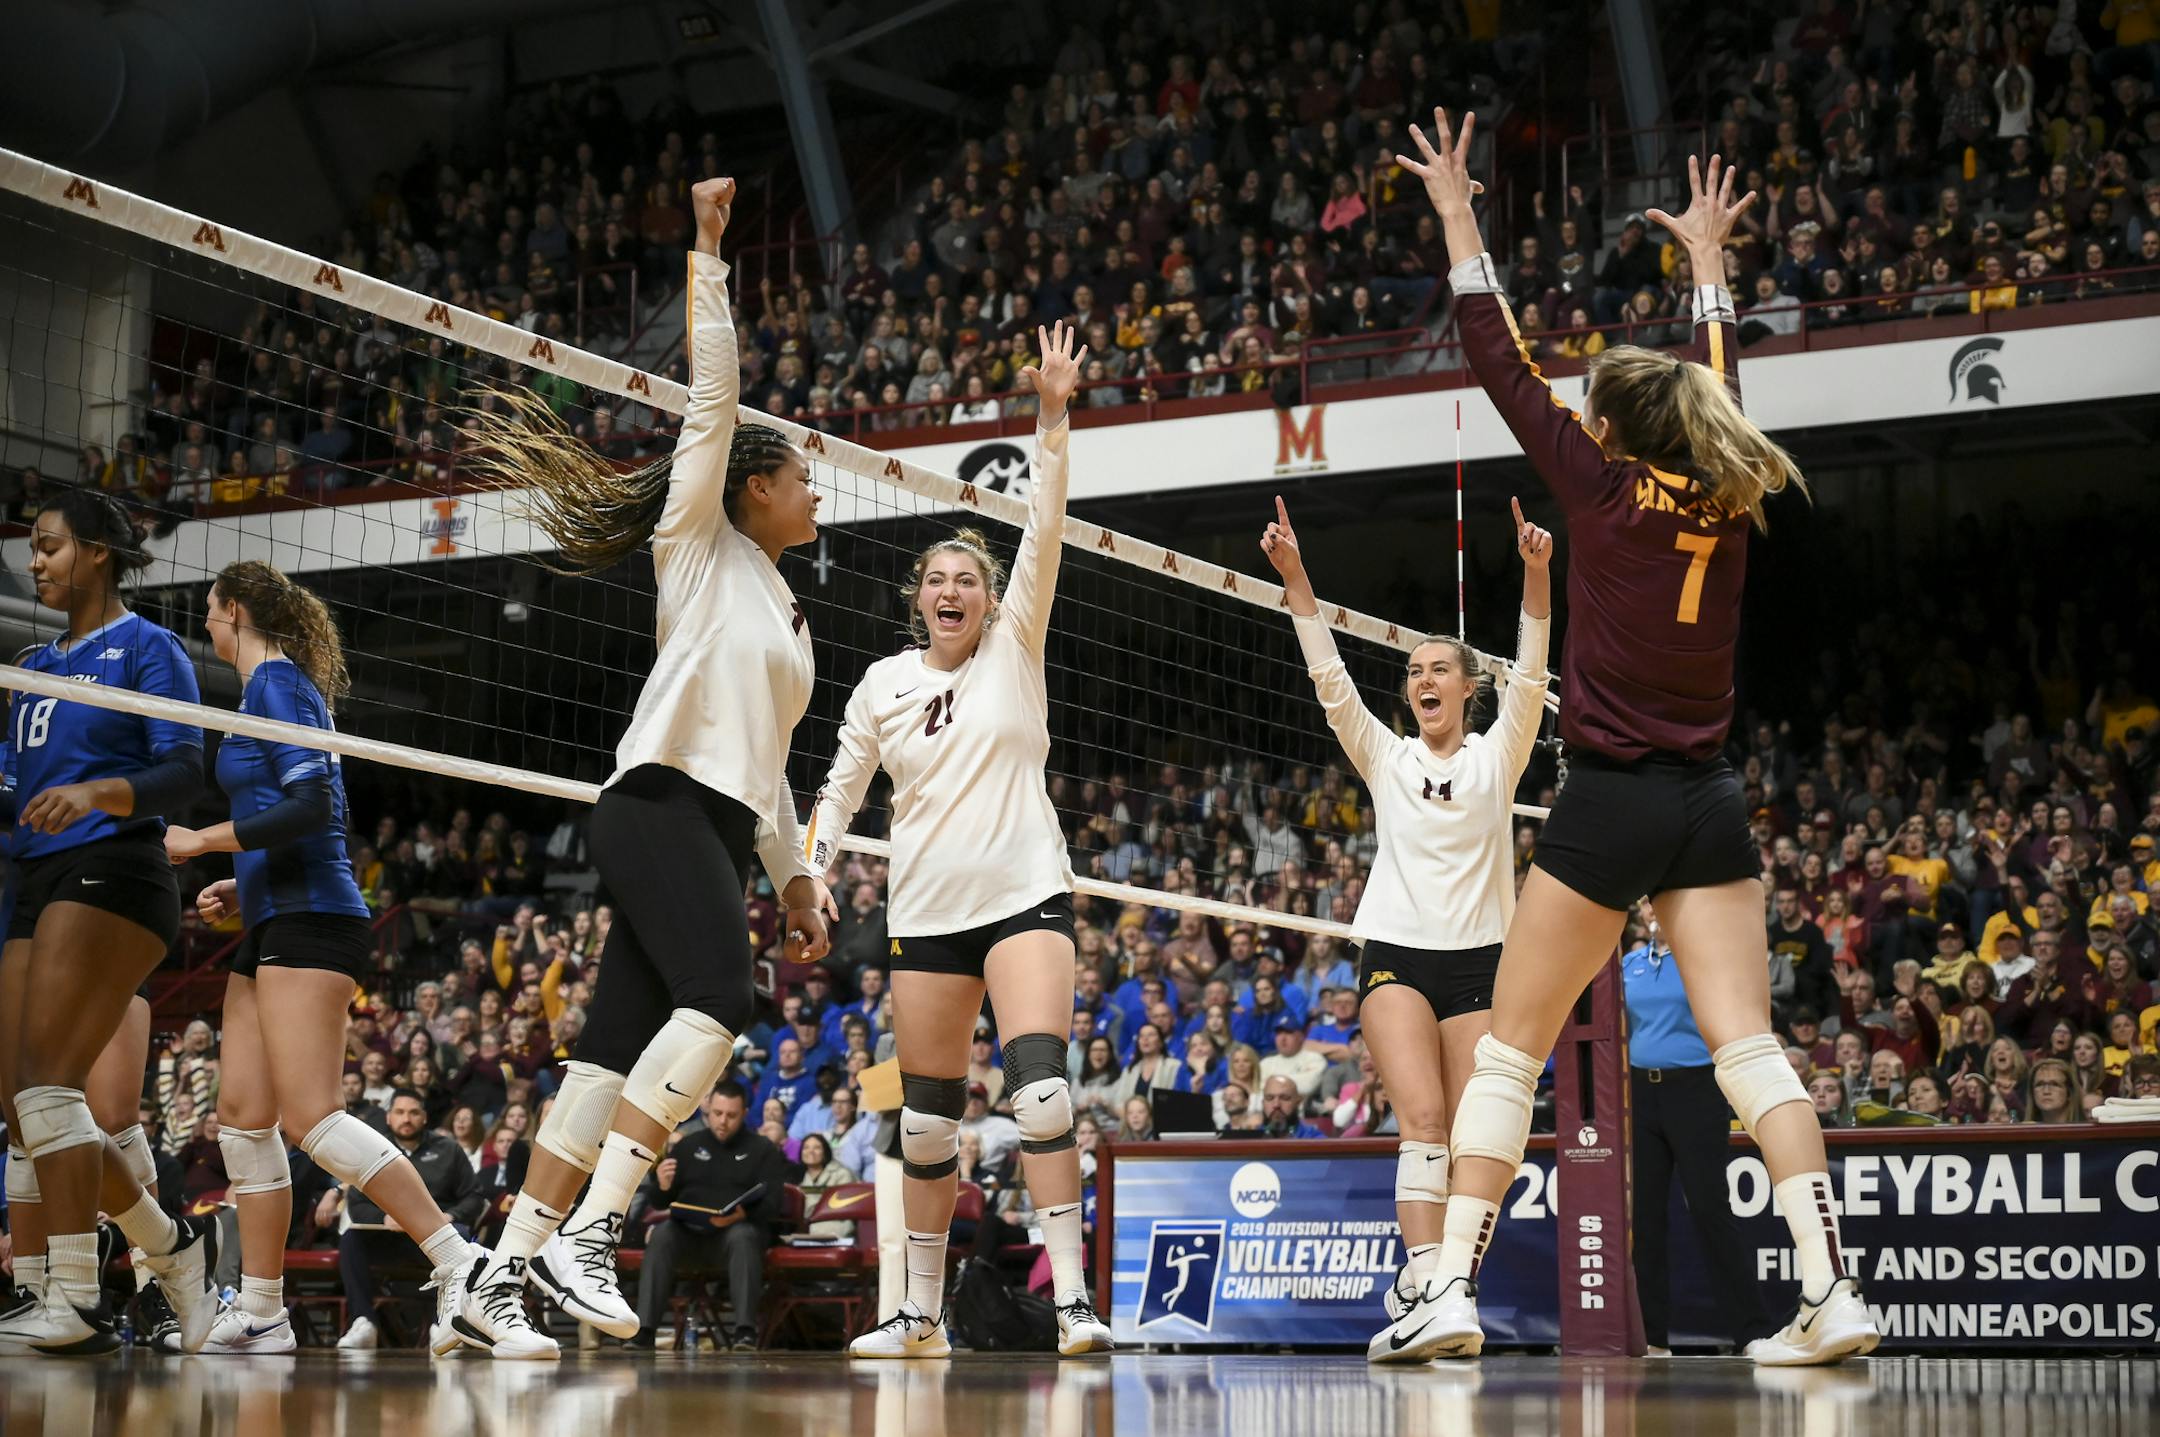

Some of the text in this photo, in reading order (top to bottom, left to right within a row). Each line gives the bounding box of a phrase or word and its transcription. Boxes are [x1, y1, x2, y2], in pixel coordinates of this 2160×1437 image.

[63, 176, 100, 208] M
[192, 222, 226, 252] M
[313, 263, 343, 292] M
[424, 302, 454, 329] M
[528, 338, 556, 364] M
[626, 371, 651, 397] M
[803, 431, 825, 454] M
[1275, 403, 1328, 465] M
[884, 457, 905, 481] M
[959, 484, 978, 506] M
[1674, 531, 1719, 624] 7
[17, 698, 58, 753] 18
[924, 689, 954, 737] 21
[1236, 1190, 1278, 1203] NCAA
[1726, 1152, 2101, 1218] OEYBALL
[1231, 1222, 1264, 1236] 2019
[1266, 1222, 1329, 1236] DIVISION
[1330, 1222, 1339, 1235] I
[1228, 1238, 1399, 1274] VOLLEYBALL
[1757, 1247, 1867, 1281] FIT
[1874, 1247, 1965, 1281] AND
[1974, 1245, 2146, 1280] SECOND
[1221, 1276, 1375, 1300] CHAMPIONSHIP
